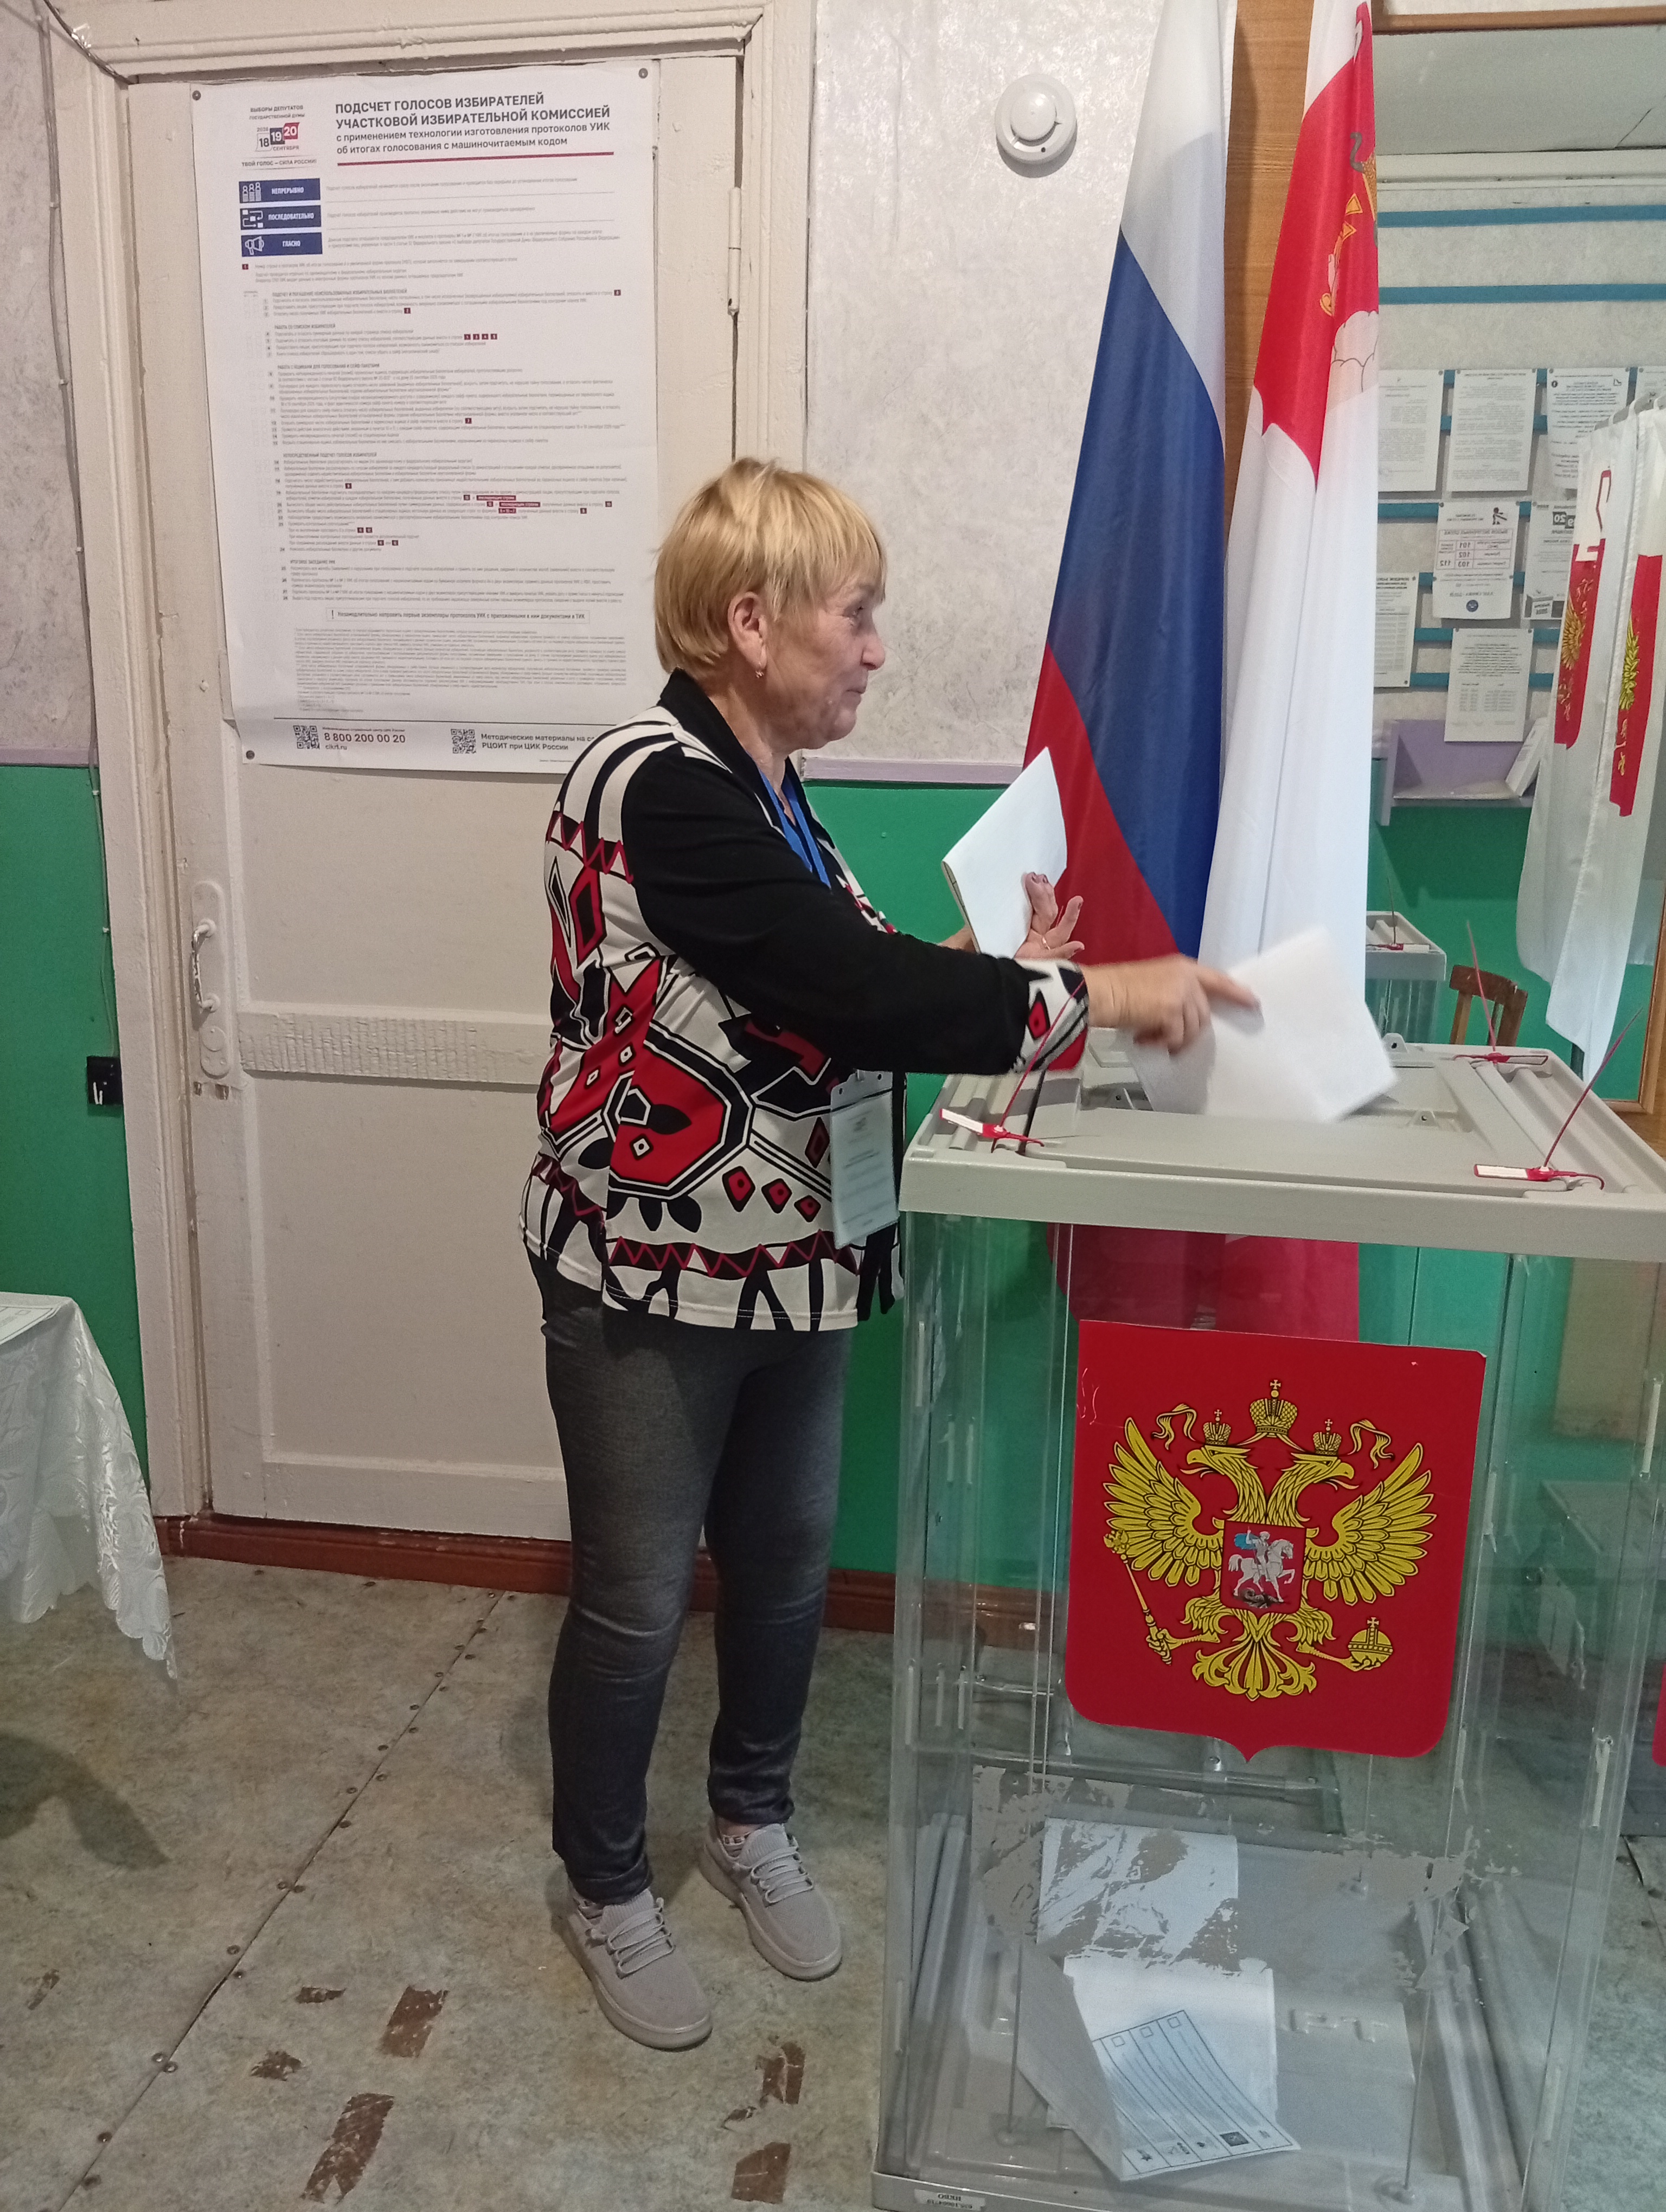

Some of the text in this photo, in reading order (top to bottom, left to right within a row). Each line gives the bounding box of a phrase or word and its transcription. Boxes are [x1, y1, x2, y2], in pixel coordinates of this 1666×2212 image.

[335, 92, 544, 114] ПОДСЧЕТ ГОЛОСОВ ИЗБИРАТЕЛЕЙ
[336, 105, 610, 129] УЧАСТКОВОЙ ИЗБИРАТЕЛЬНОЙ КОМИССИЕЙ
[259, 126, 297, 147] 18 19 20
[344, 132, 406, 143] применением
[409, 130, 462, 139] технологии
[464, 127, 529, 136] изготовления
[531, 124, 587, 135] протоколов
[589, 122, 610, 131] УИК
[337, 145, 348, 154] об
[350, 146, 380, 154] итогах
[383, 143, 441, 152] голосования
[451, 139, 535, 149] машиночитаемым
[538, 138, 567, 146] кодом
[271, 187, 304, 195] НЕПРЕРЫВНО
[268, 213, 315, 221] ПОСЛЕДОВАТЕЛЬНО
[324, 732, 406, 743] 8 800 200 00 20
